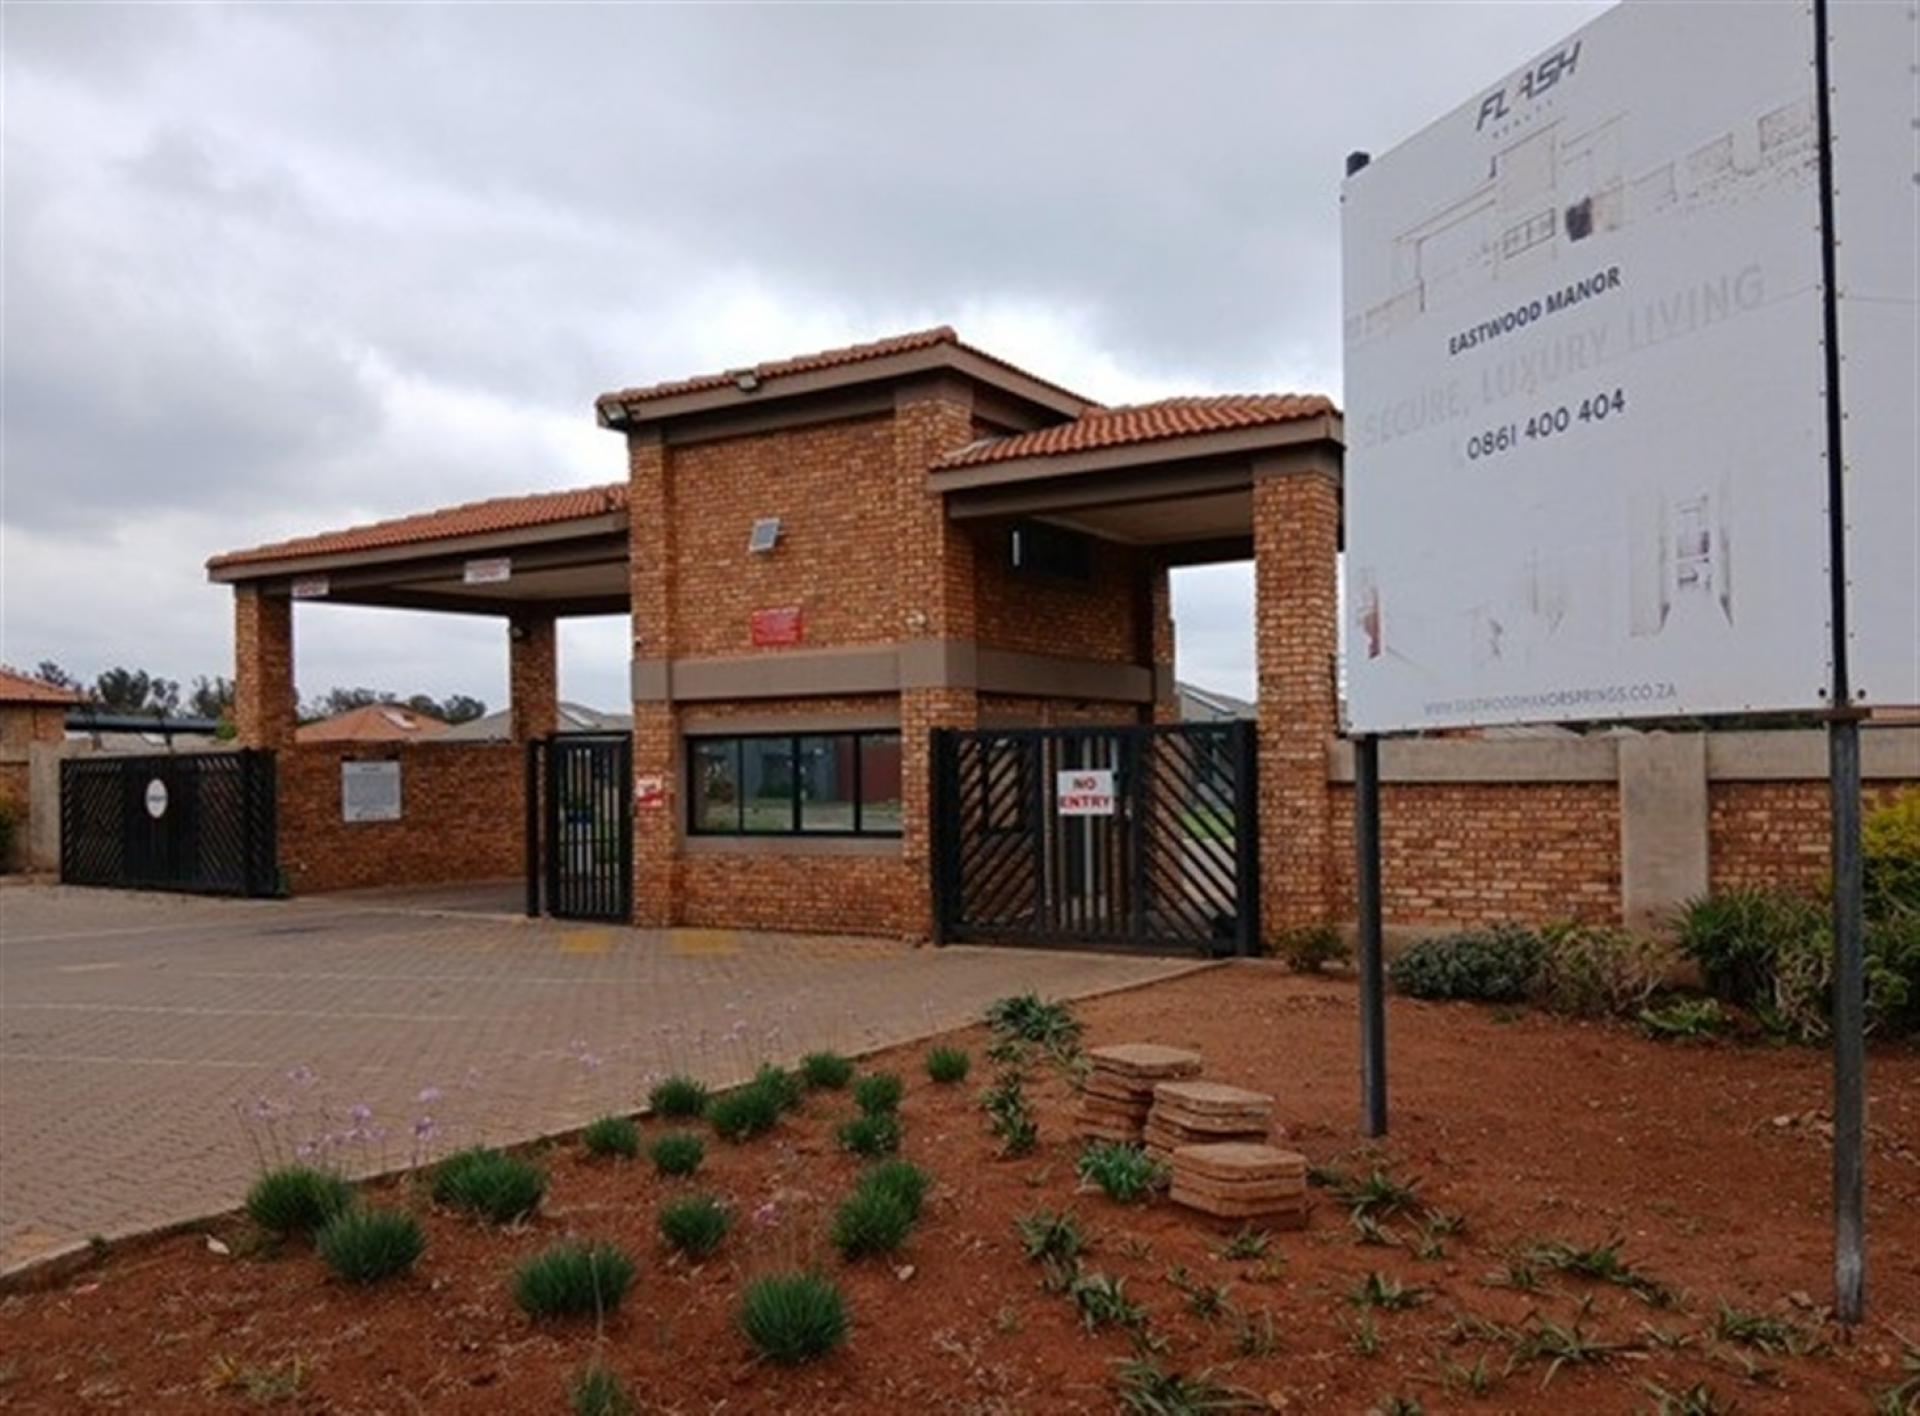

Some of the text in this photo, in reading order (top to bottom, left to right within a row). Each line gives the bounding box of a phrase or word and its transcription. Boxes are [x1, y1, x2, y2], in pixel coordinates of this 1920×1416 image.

[1476, 39, 1582, 131] FLASH
[1448, 265, 1621, 356] EASTWOOD MANOR
[1483, 322, 1608, 405] LUXURY
[1628, 264, 1765, 350] LIVING
[1466, 387, 1626, 462] 0861 400 404
[1059, 795, 1109, 809] ENTRY
[1072, 776, 1097, 790] NO
